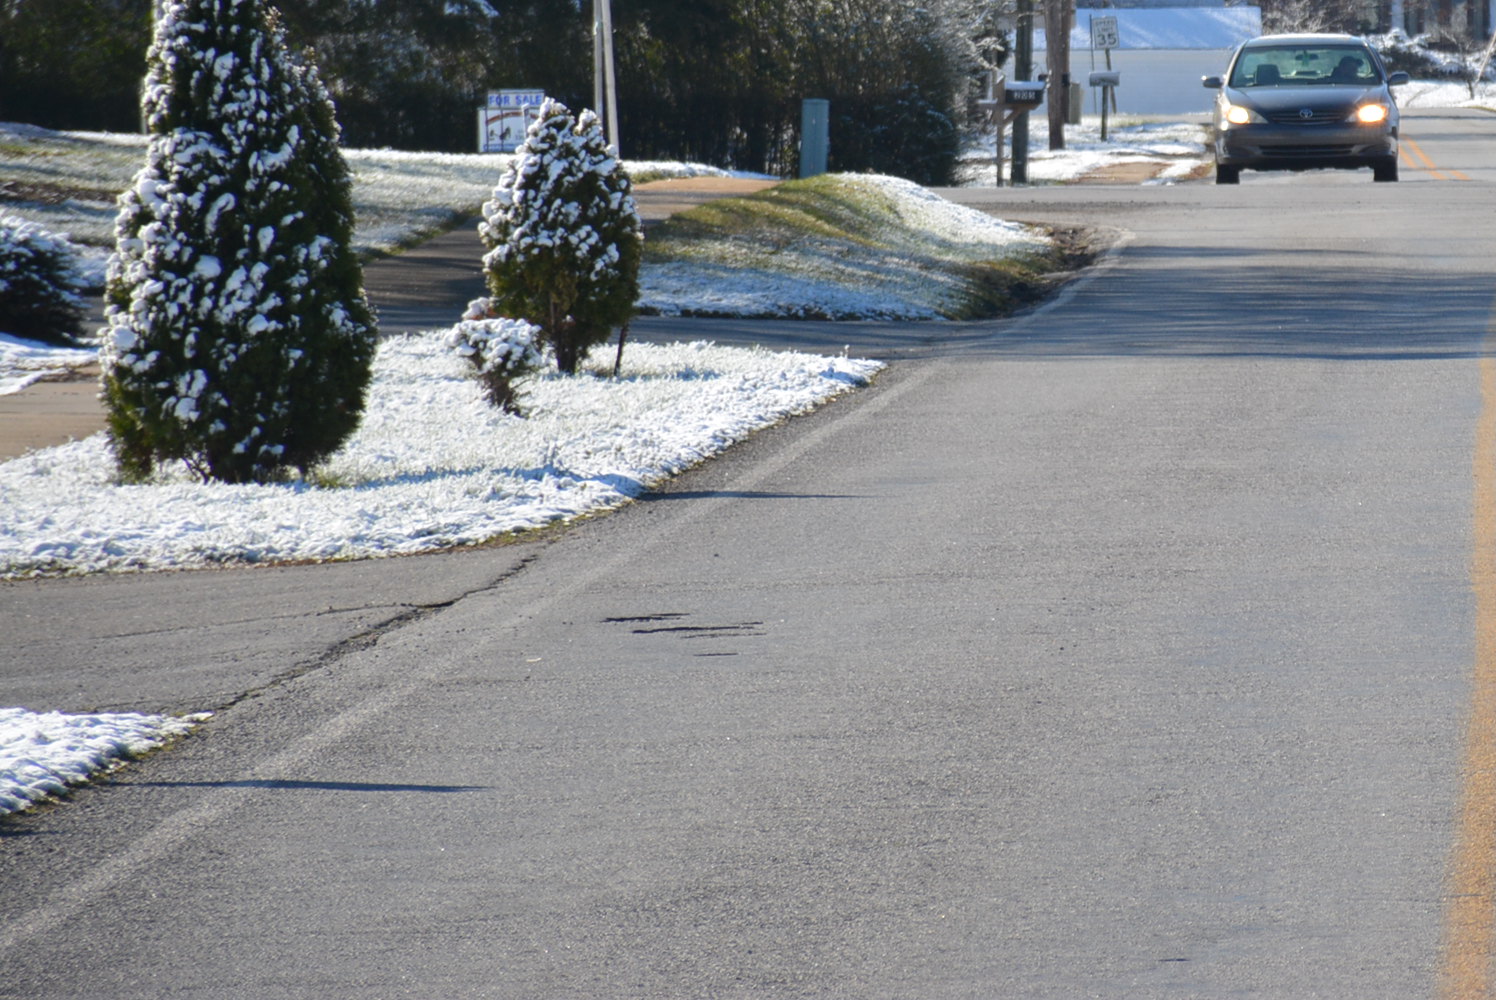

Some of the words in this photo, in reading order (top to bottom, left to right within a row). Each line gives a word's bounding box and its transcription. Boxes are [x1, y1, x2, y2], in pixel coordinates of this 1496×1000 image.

[1098, 33, 1117, 46] 35
[488, 95, 510, 106] FOR
[515, 94, 542, 106] SALE
